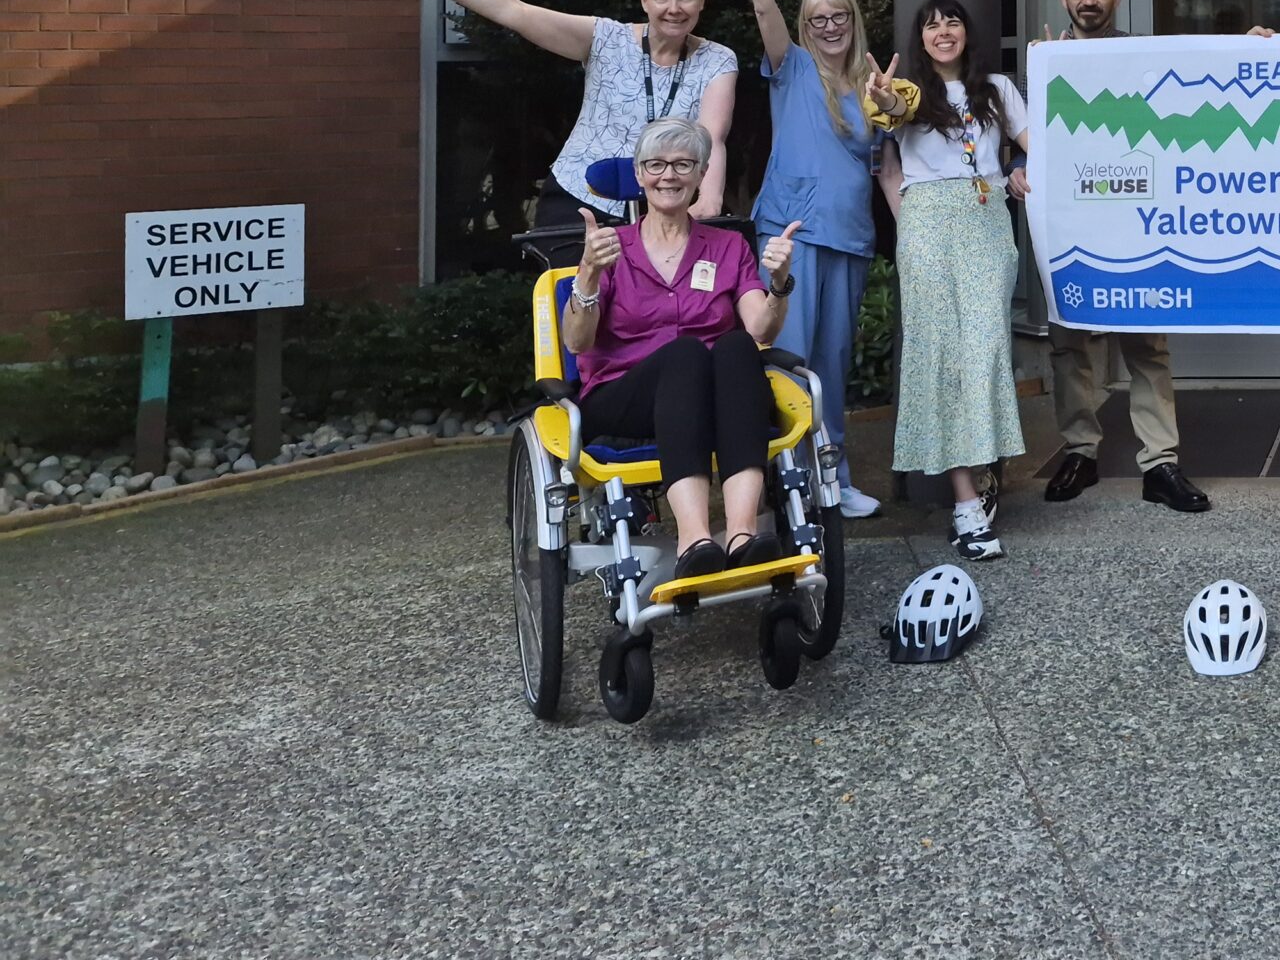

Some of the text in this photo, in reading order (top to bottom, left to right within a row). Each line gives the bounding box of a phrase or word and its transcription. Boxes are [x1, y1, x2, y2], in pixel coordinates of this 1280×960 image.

[1074, 162, 1148, 182] Yaletown
[1081, 179, 1148, 195] HUSE
[146, 217, 285, 246] SERVICE
[146, 248, 285, 278] VEHICLE
[174, 281, 260, 308] ONLY
[1092, 286, 1192, 309] BRITSH
